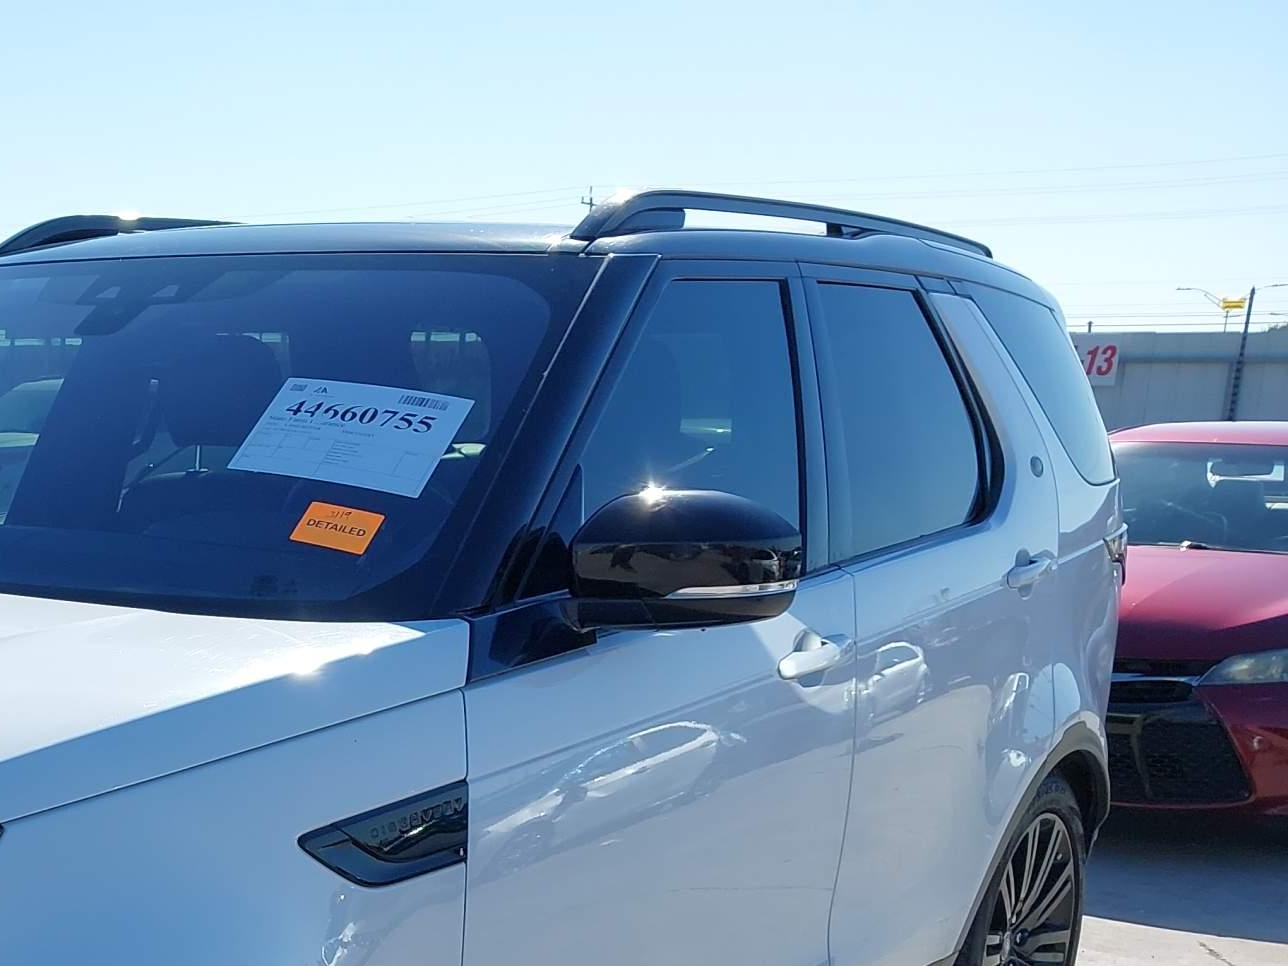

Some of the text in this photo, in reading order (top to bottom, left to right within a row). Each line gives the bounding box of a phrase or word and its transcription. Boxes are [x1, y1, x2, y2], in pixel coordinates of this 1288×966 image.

[1082, 344, 1117, 376] 13
[286, 399, 437, 433] 44660755
[306, 518, 366, 537] DETAILED
